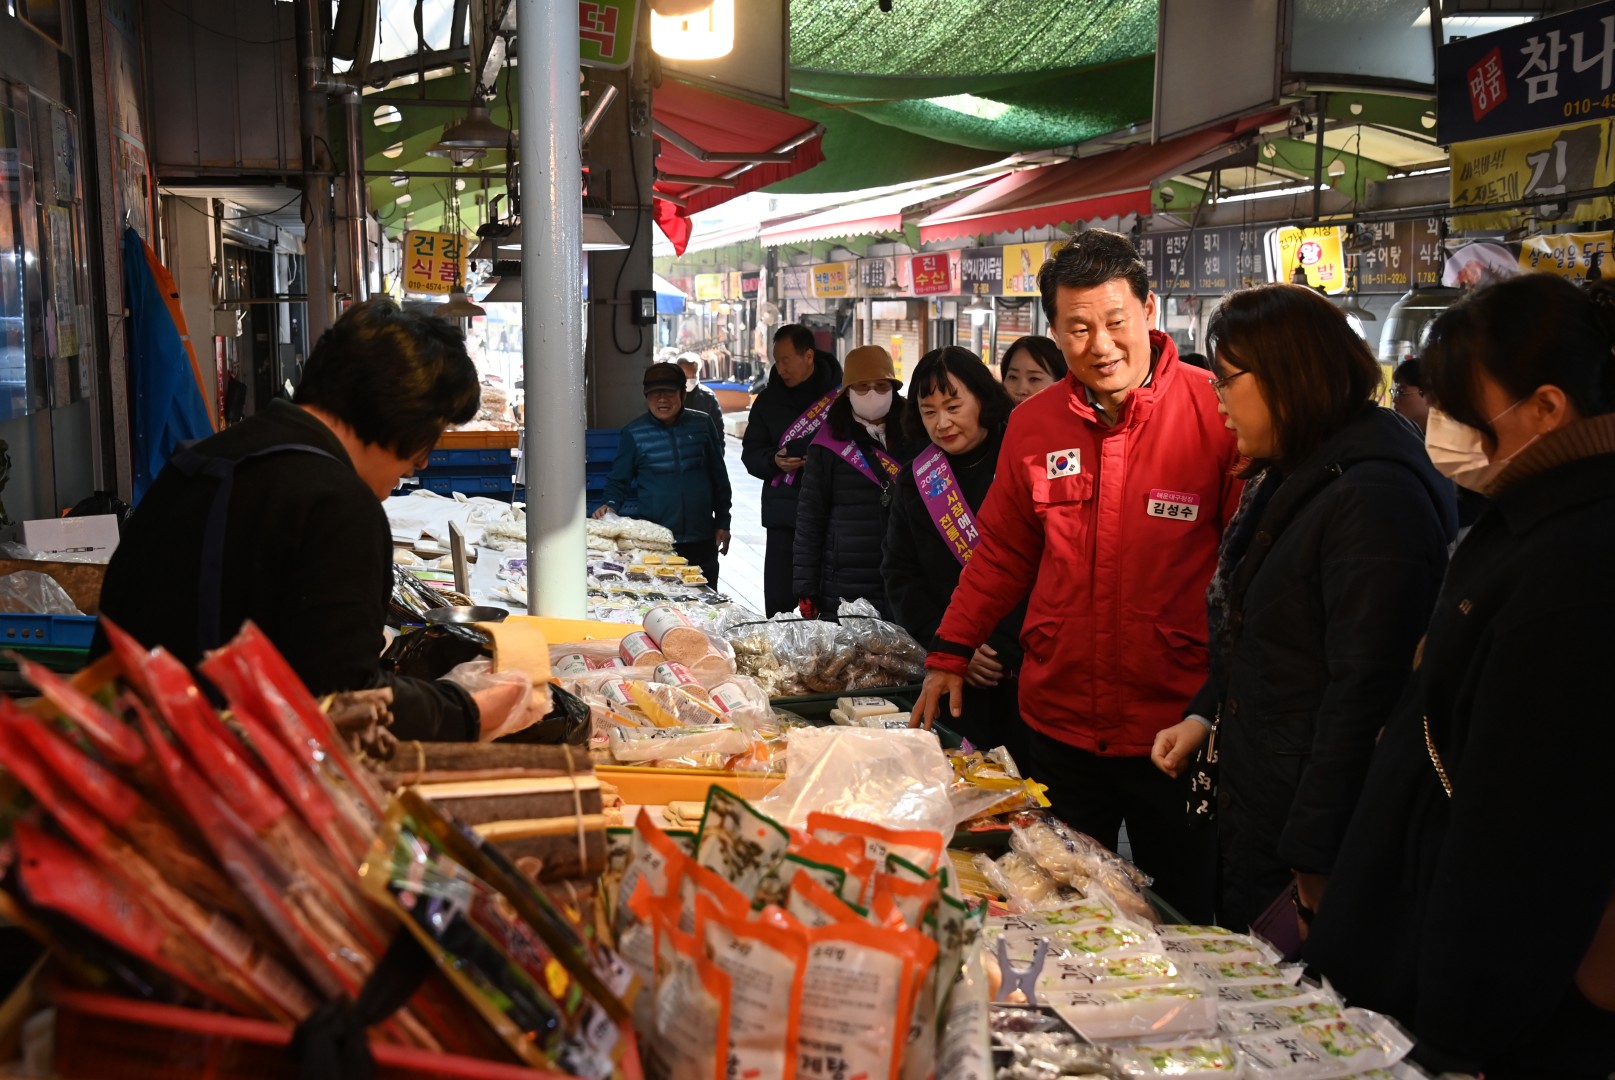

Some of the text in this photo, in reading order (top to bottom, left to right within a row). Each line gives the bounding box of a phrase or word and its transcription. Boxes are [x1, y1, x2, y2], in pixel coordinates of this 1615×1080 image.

[1470, 55, 1501, 110] 명품
[1524, 140, 1568, 217] 김
[413, 235, 464, 260] 건강
[1204, 234, 1220, 252] 돼지
[411, 258, 462, 283] 식품
[922, 257, 936, 271] 진
[1204, 257, 1220, 275] 상회
[408, 280, 454, 292] 010-4574-1
[915, 272, 946, 286] 수산
[920, 463, 948, 489] 2025
[1156, 492, 1194, 503] 해운대구청장
[946, 489, 979, 542] 시장에서
[1153, 502, 1193, 518] 김성수
